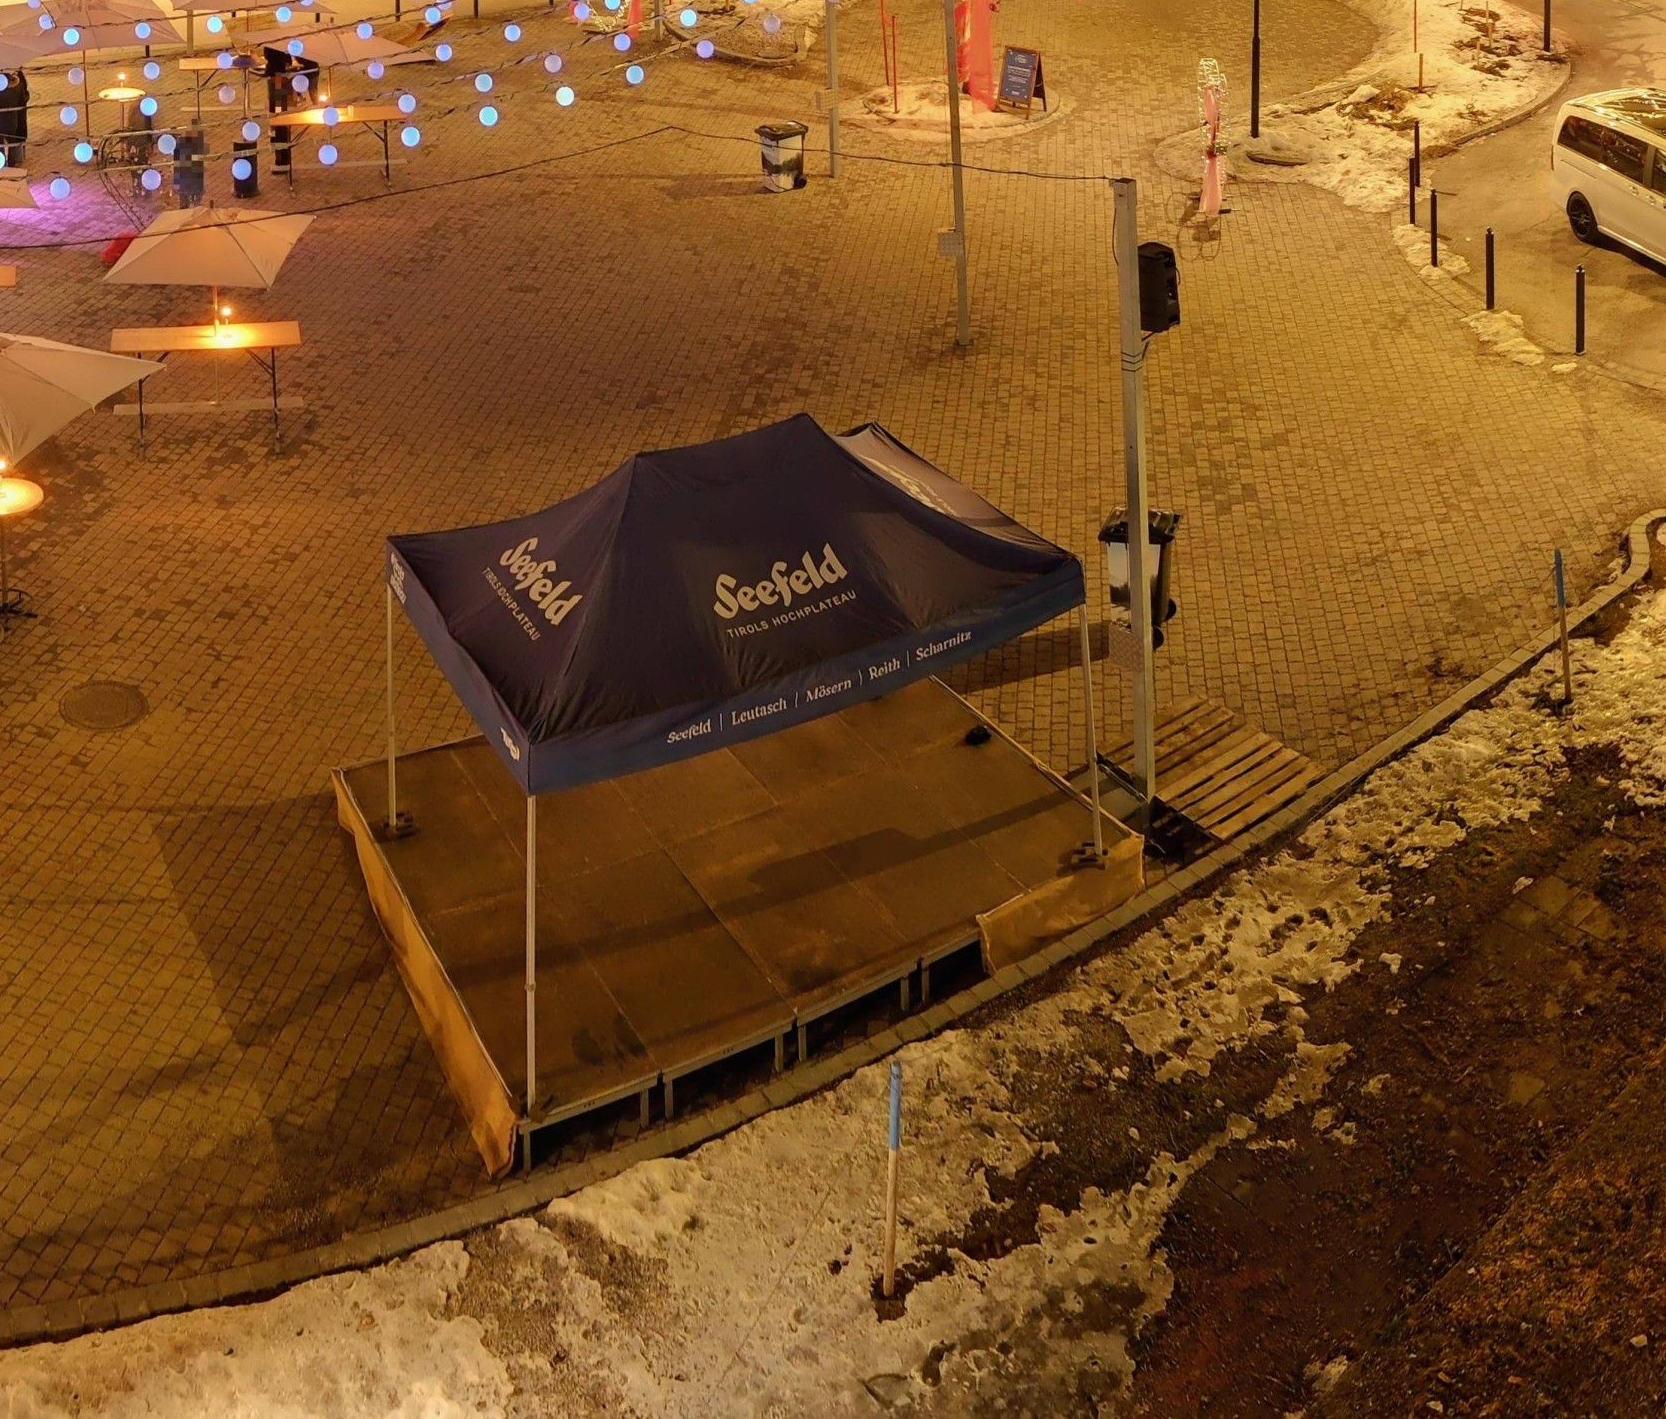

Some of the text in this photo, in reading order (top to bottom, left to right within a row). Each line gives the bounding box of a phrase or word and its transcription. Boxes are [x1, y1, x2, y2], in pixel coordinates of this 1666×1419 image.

[499, 537, 583, 626] Seefeld
[713, 542, 848, 619] Seefeld
[726, 589, 857, 638] TIROLS HOCHPLATEAU
[666, 631, 972, 744] Seefeld Leutasch Mösern Reith Scharnitz
